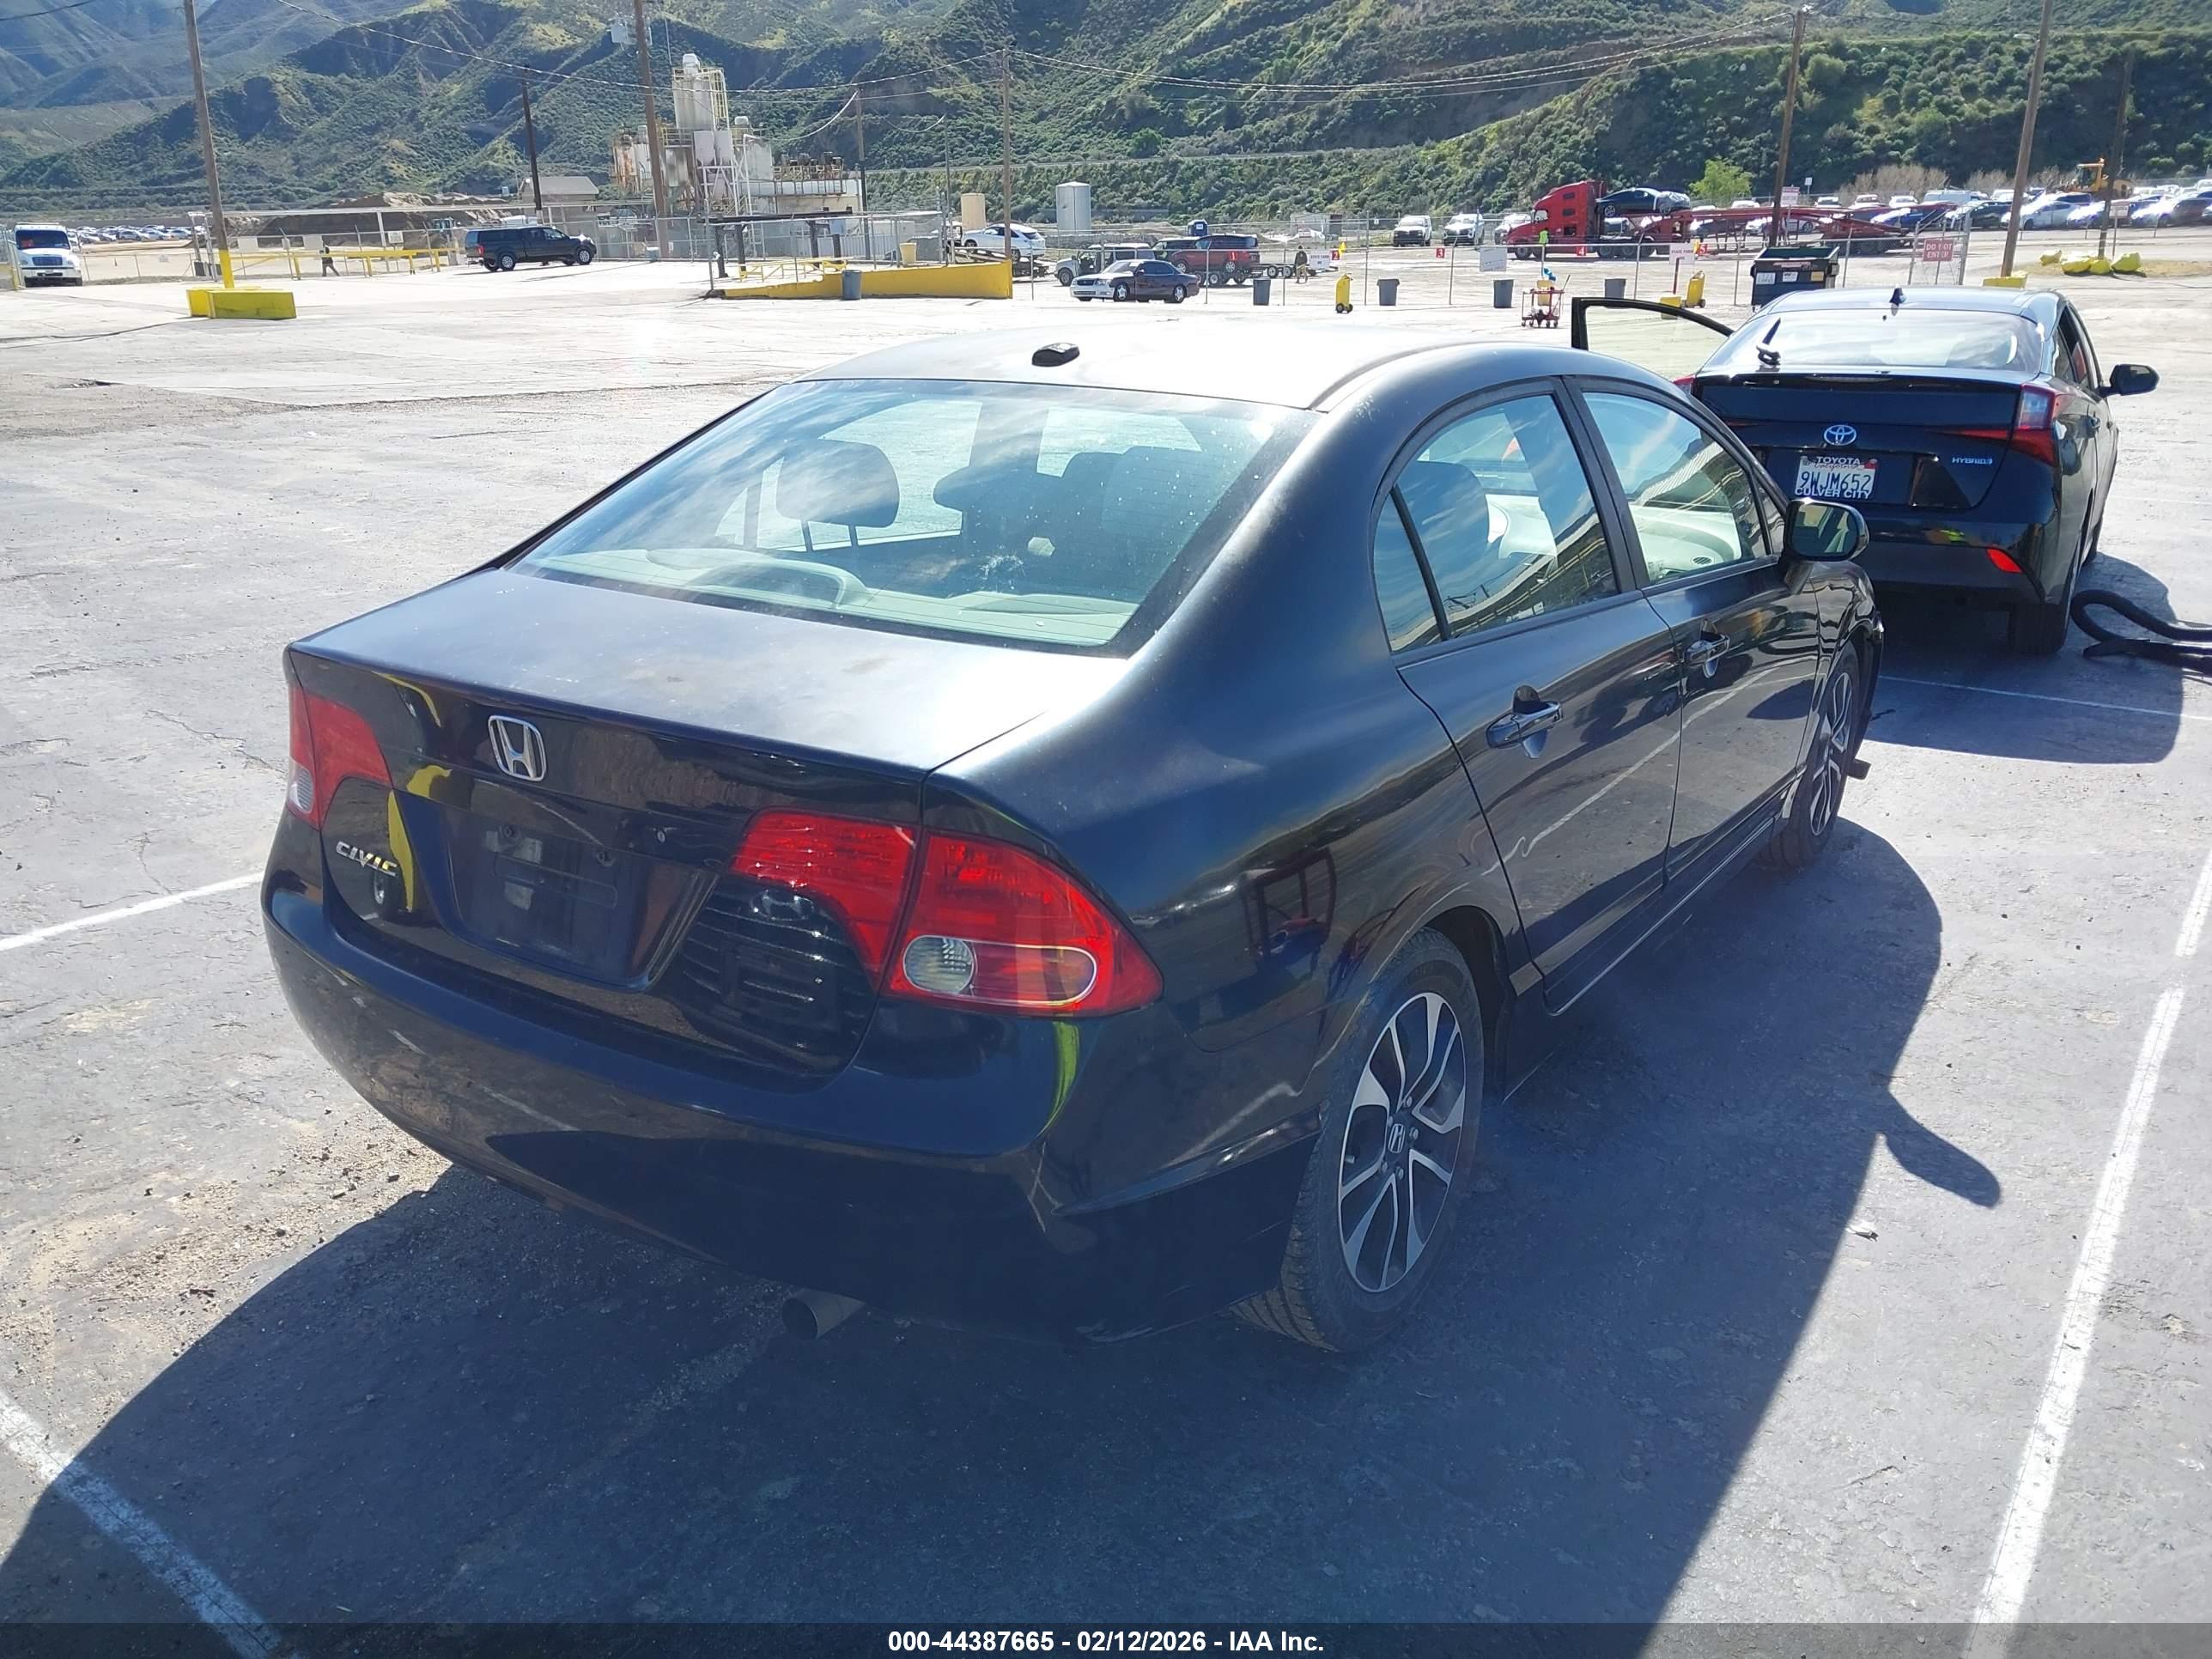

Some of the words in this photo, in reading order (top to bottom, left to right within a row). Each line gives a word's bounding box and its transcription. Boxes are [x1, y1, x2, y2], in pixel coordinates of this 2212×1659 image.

[1816, 456, 1861, 465] TOYOTA
[1800, 471, 1871, 492] 9WJM652
[1795, 487, 1840, 498] CULVER
[1844, 489, 1870, 499] CITY
[336, 841, 398, 877] CIVIC
